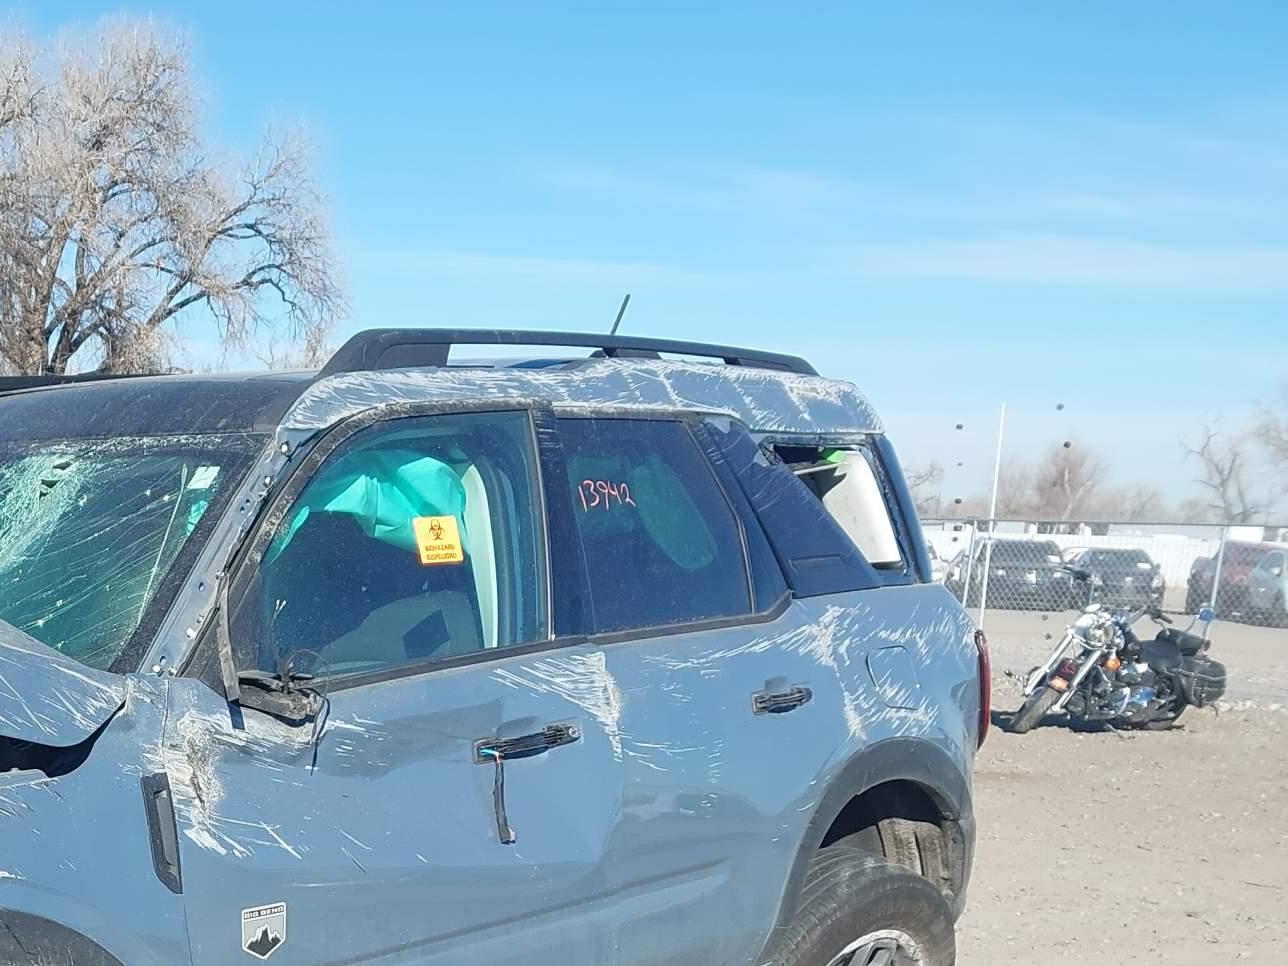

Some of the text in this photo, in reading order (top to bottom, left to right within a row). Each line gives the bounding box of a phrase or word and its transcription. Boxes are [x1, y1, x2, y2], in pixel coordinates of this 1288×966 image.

[578, 479, 636, 512] 13942
[244, 905, 284, 919] BIG BEND
